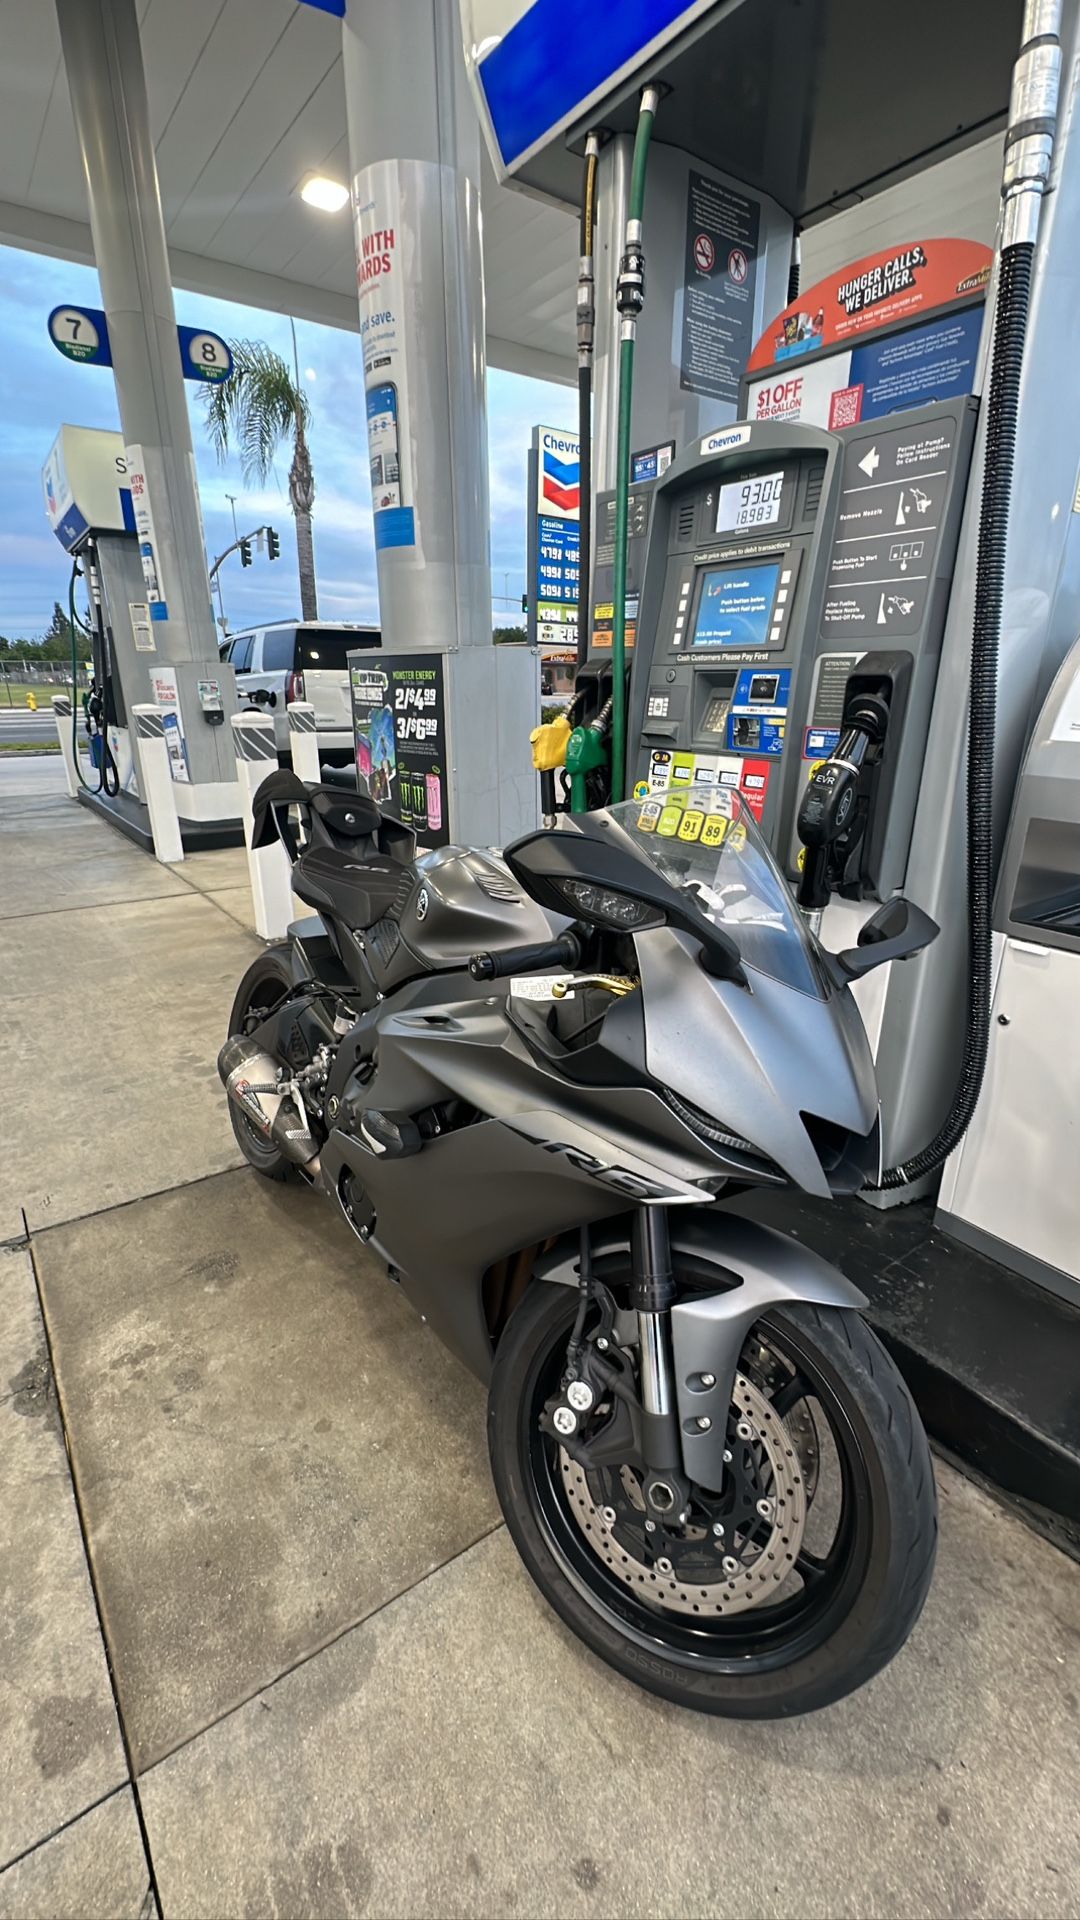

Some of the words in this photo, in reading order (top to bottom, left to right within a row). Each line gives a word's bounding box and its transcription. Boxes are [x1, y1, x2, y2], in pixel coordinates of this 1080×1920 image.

[838, 267, 881, 302] HUNGER
[884, 247, 924, 277] CALLS,
[845, 292, 861, 313] WE
[864, 269, 913, 304] DELIVER.
[371, 311, 395, 328] save.
[65, 317, 81, 340] 7
[202, 342, 216, 362] 8
[757, 387, 771, 409] $1
[773, 377, 804, 404] OFF
[756, 408, 770, 420] PER
[771, 398, 802, 415] GALLON
[543, 434, 580, 456] Chevro
[708, 433, 742, 450] Chevron
[905, 456, 918, 464] Card
[706, 493, 712, 506] $
[863, 508, 882, 516] Nozzle
[541, 520, 563, 529] Gasoline
[693, 553, 708, 562] Credit
[708, 552, 720, 560] price
[720, 549, 737, 559] applies
[744, 546, 757, 554] debit
[758, 542, 790, 552] transactions
[691, 653, 720, 661] Customers
[741, 652, 753, 662] Pay
[754, 652, 769, 660] First
[392, 670, 415, 680] MONSTER
[416, 671, 436, 680] ENERGY
[815, 774, 835, 785] EVR
[743, 792, 764, 801] egular
[683, 820, 696, 833] 91
[705, 825, 721, 839] 89
